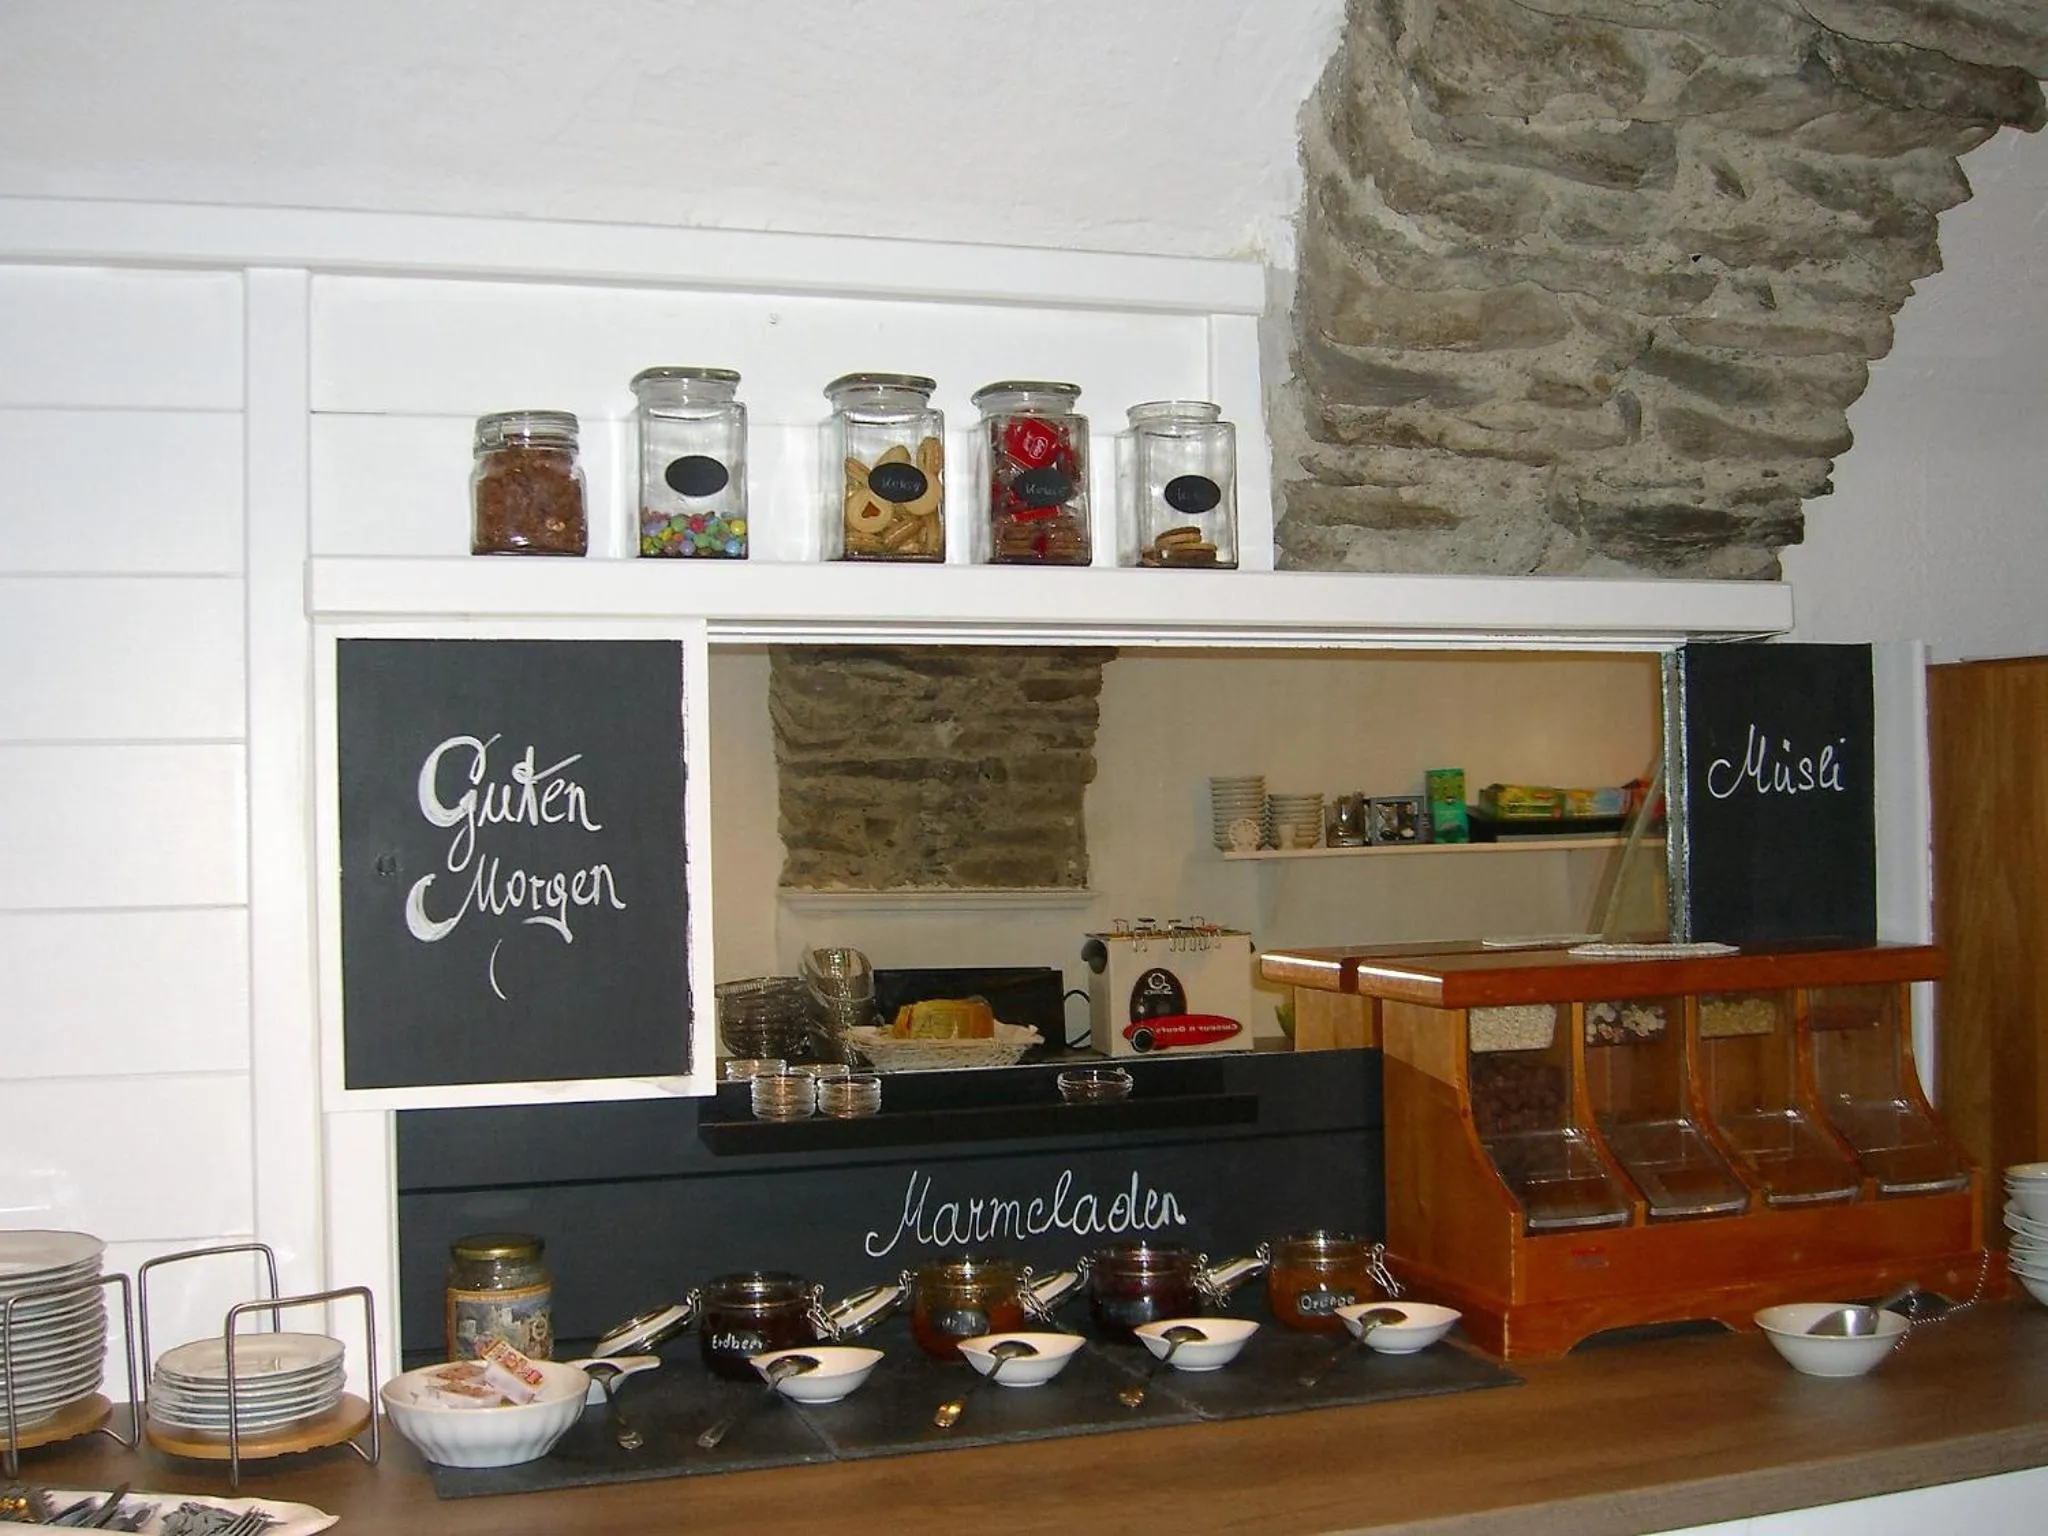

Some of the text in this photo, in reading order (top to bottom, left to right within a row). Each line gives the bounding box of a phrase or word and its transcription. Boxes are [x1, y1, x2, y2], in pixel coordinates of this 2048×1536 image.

[1707, 723, 1847, 799] Müsli
[418, 733, 602, 872] Guten
[405, 853, 627, 944] Morgen
[865, 1169, 1187, 1257] Marmeladen
[711, 1332, 764, 1350] Erdbeer
[1301, 1294, 1356, 1311] Orange
